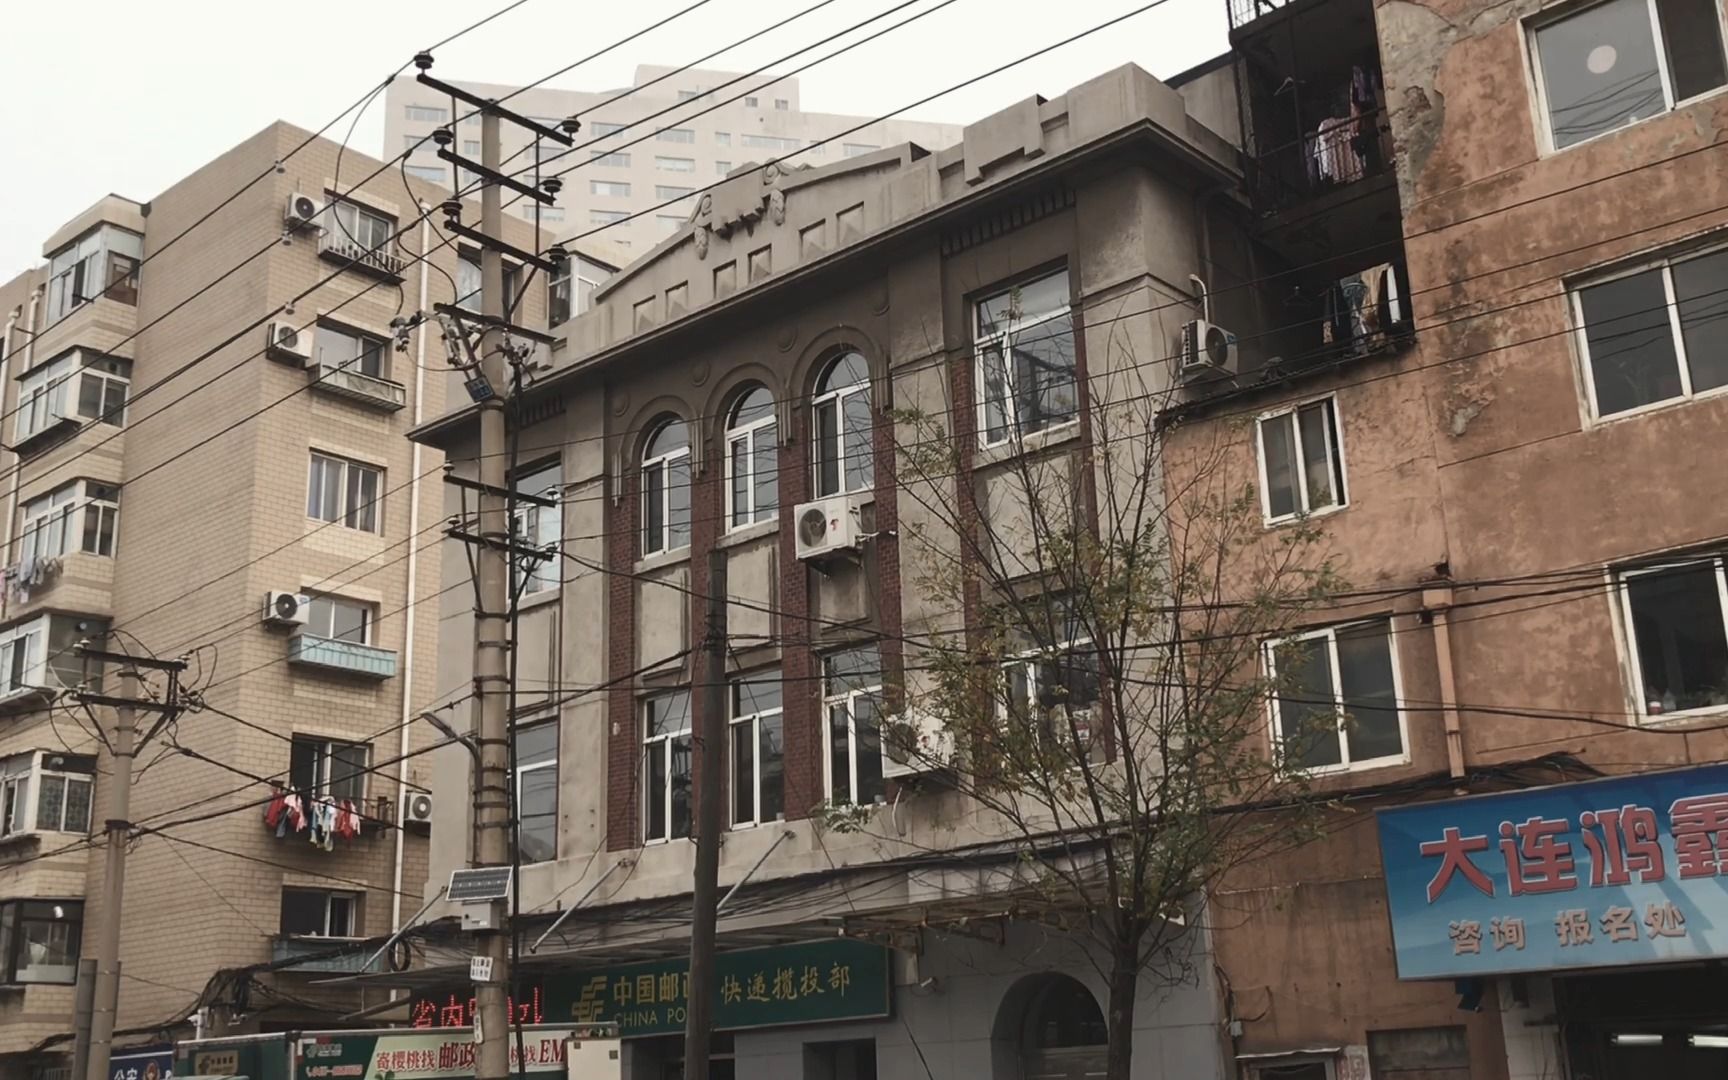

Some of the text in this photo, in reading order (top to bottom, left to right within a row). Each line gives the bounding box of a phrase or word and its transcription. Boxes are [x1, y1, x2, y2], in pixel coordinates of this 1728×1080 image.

[1419, 792, 1728, 904] 大连鸿鑫
[1448, 900, 1686, 956] 咨询 报名处
[720, 962, 851, 1005] 快递揽投部
[614, 1007, 687, 1028] CHINA PO
